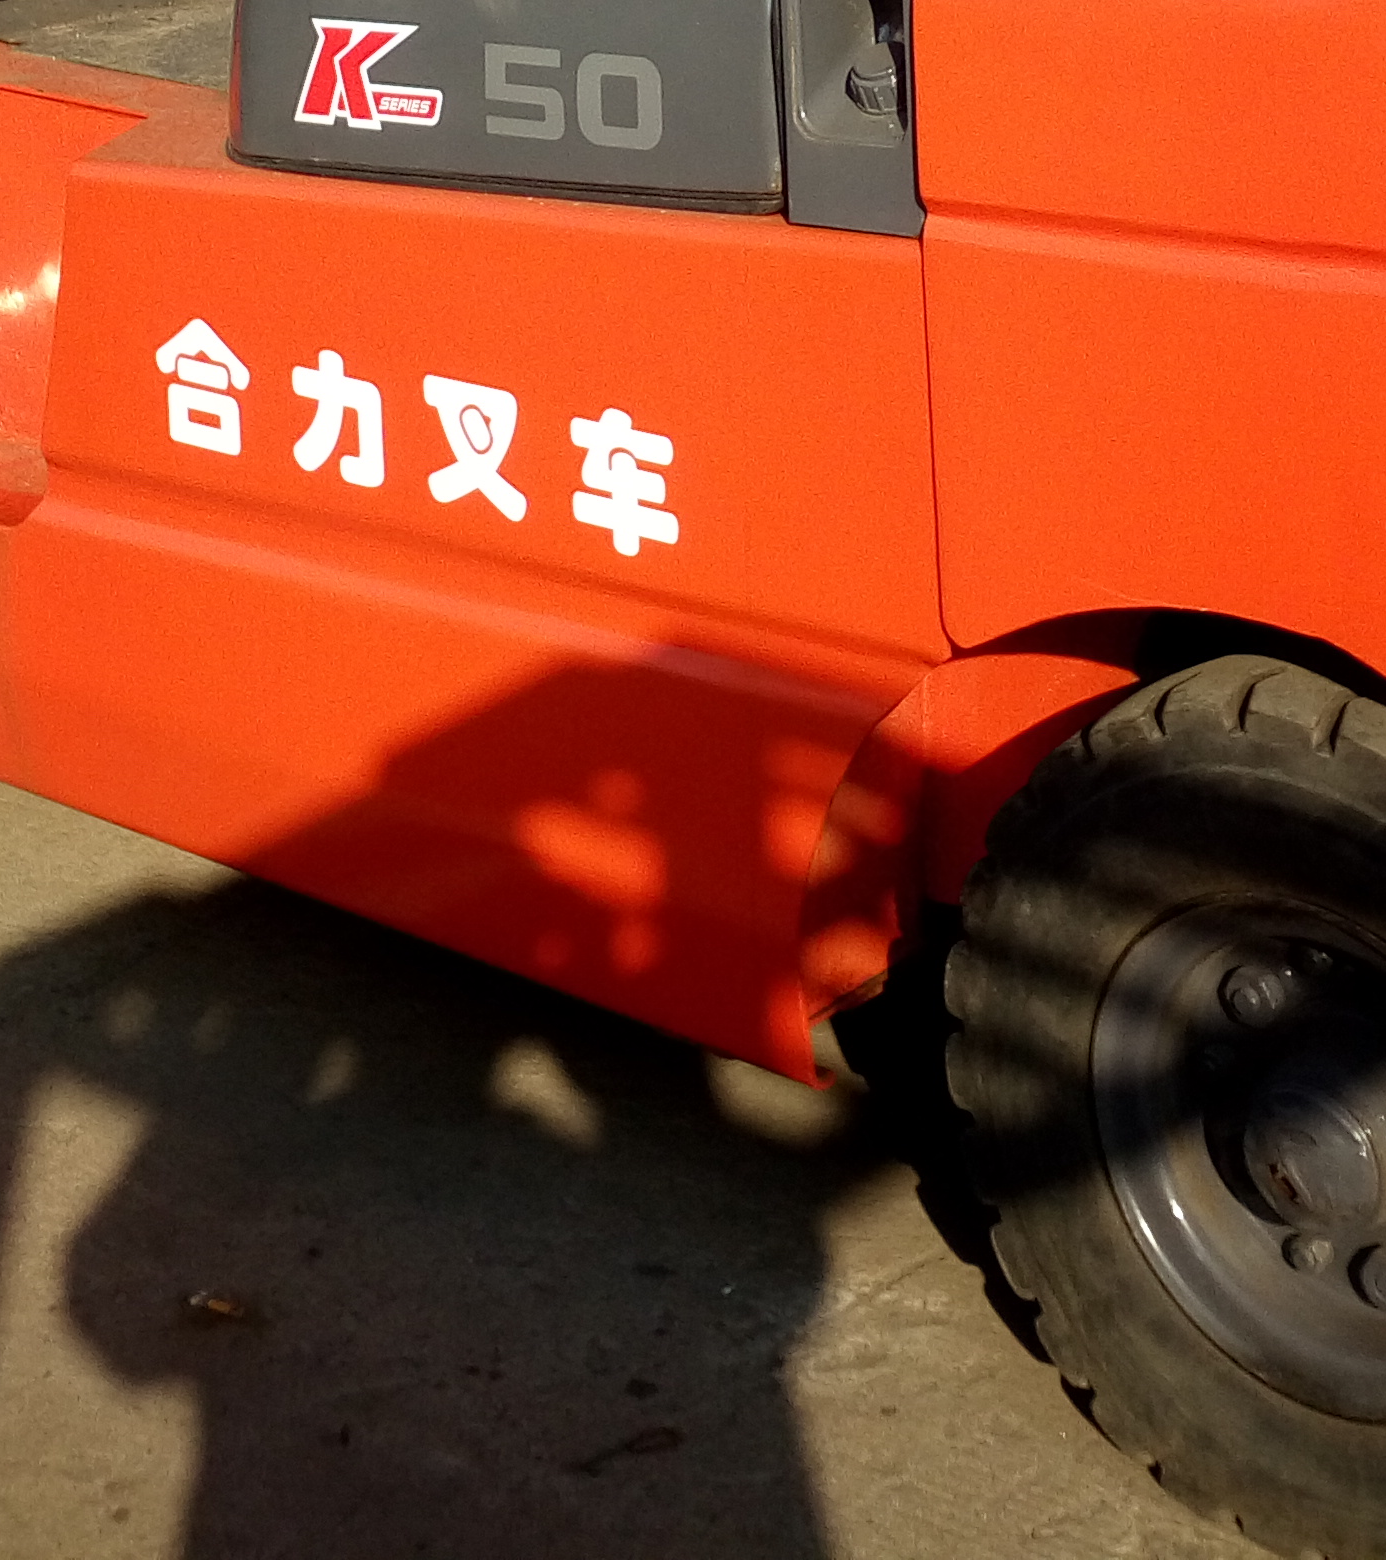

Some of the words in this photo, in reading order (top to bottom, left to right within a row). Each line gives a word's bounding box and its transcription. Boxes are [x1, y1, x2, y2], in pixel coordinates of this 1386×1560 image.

[297, 20, 415, 128] K
[378, 96, 432, 114] SERIES
[484, 42, 663, 151] 50
[154, 316, 680, 557] 合力叉车
